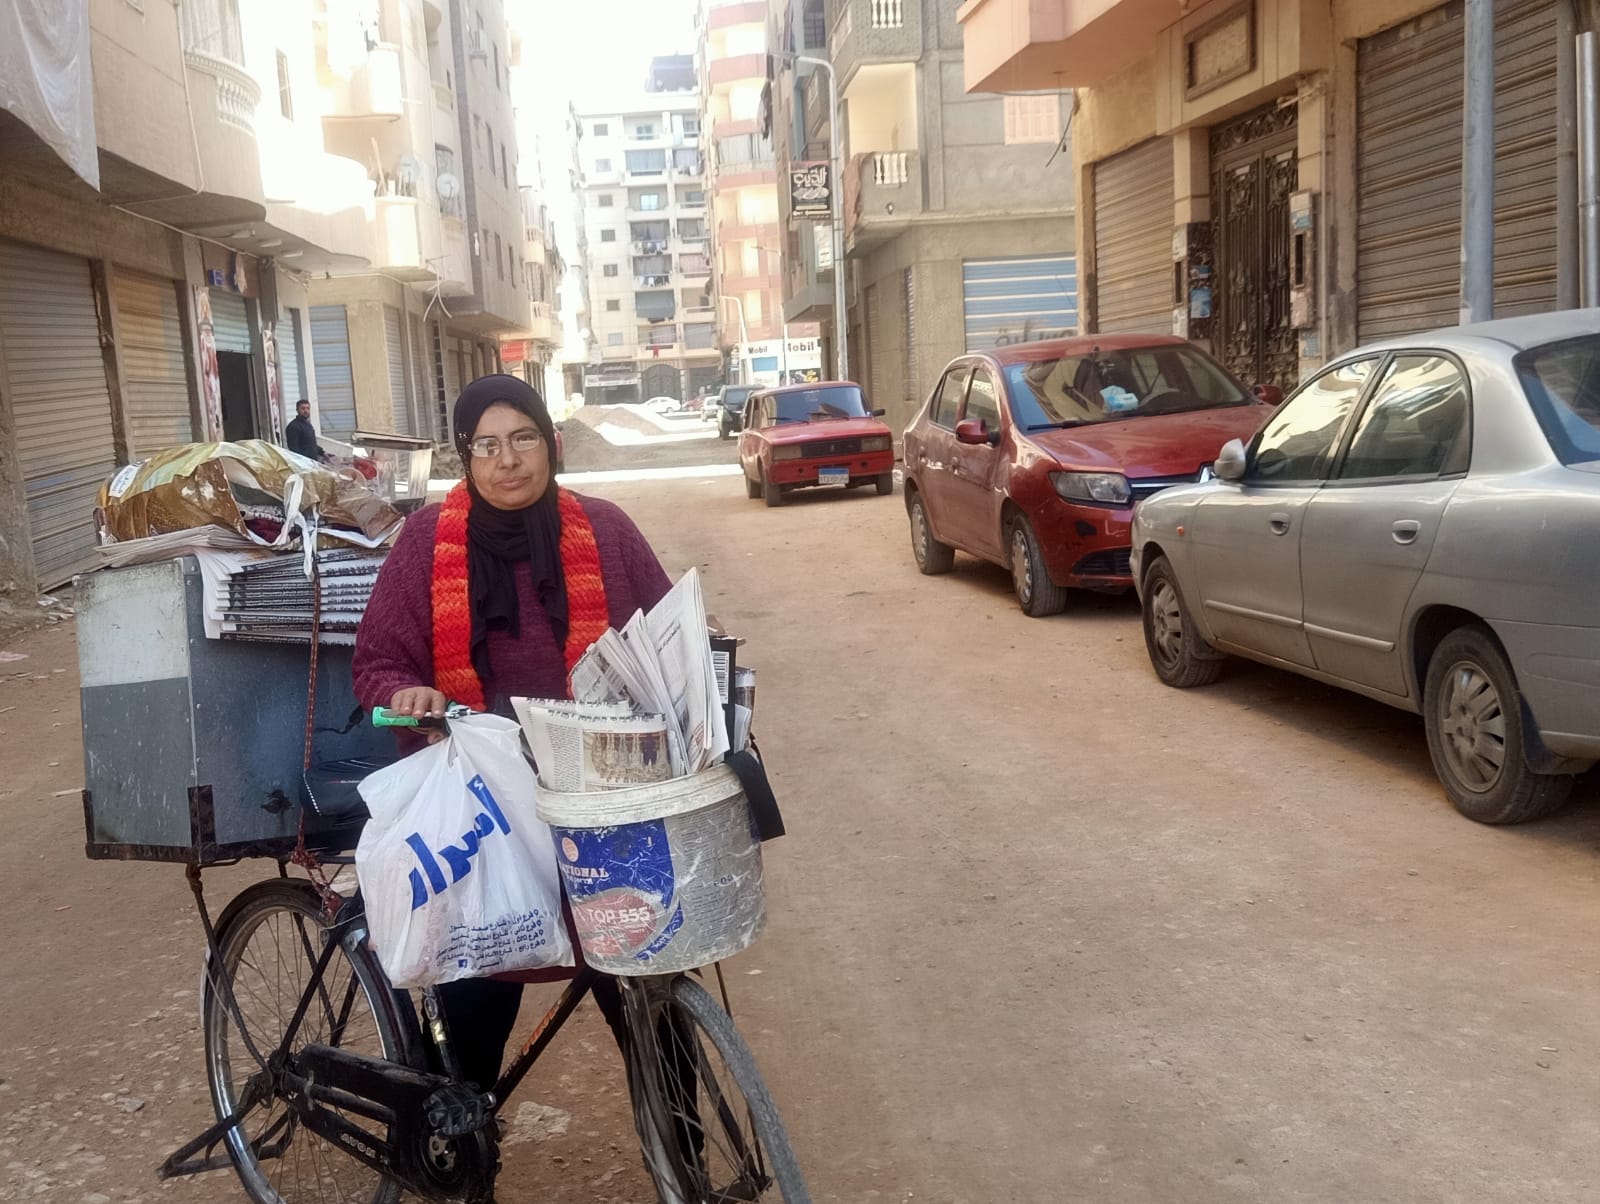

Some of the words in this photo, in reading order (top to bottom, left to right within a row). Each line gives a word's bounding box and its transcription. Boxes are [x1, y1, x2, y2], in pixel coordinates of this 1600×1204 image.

[748, 345, 768, 355] Mobil
[586, 908, 616, 925] TOP
[619, 906, 650, 923] 555
